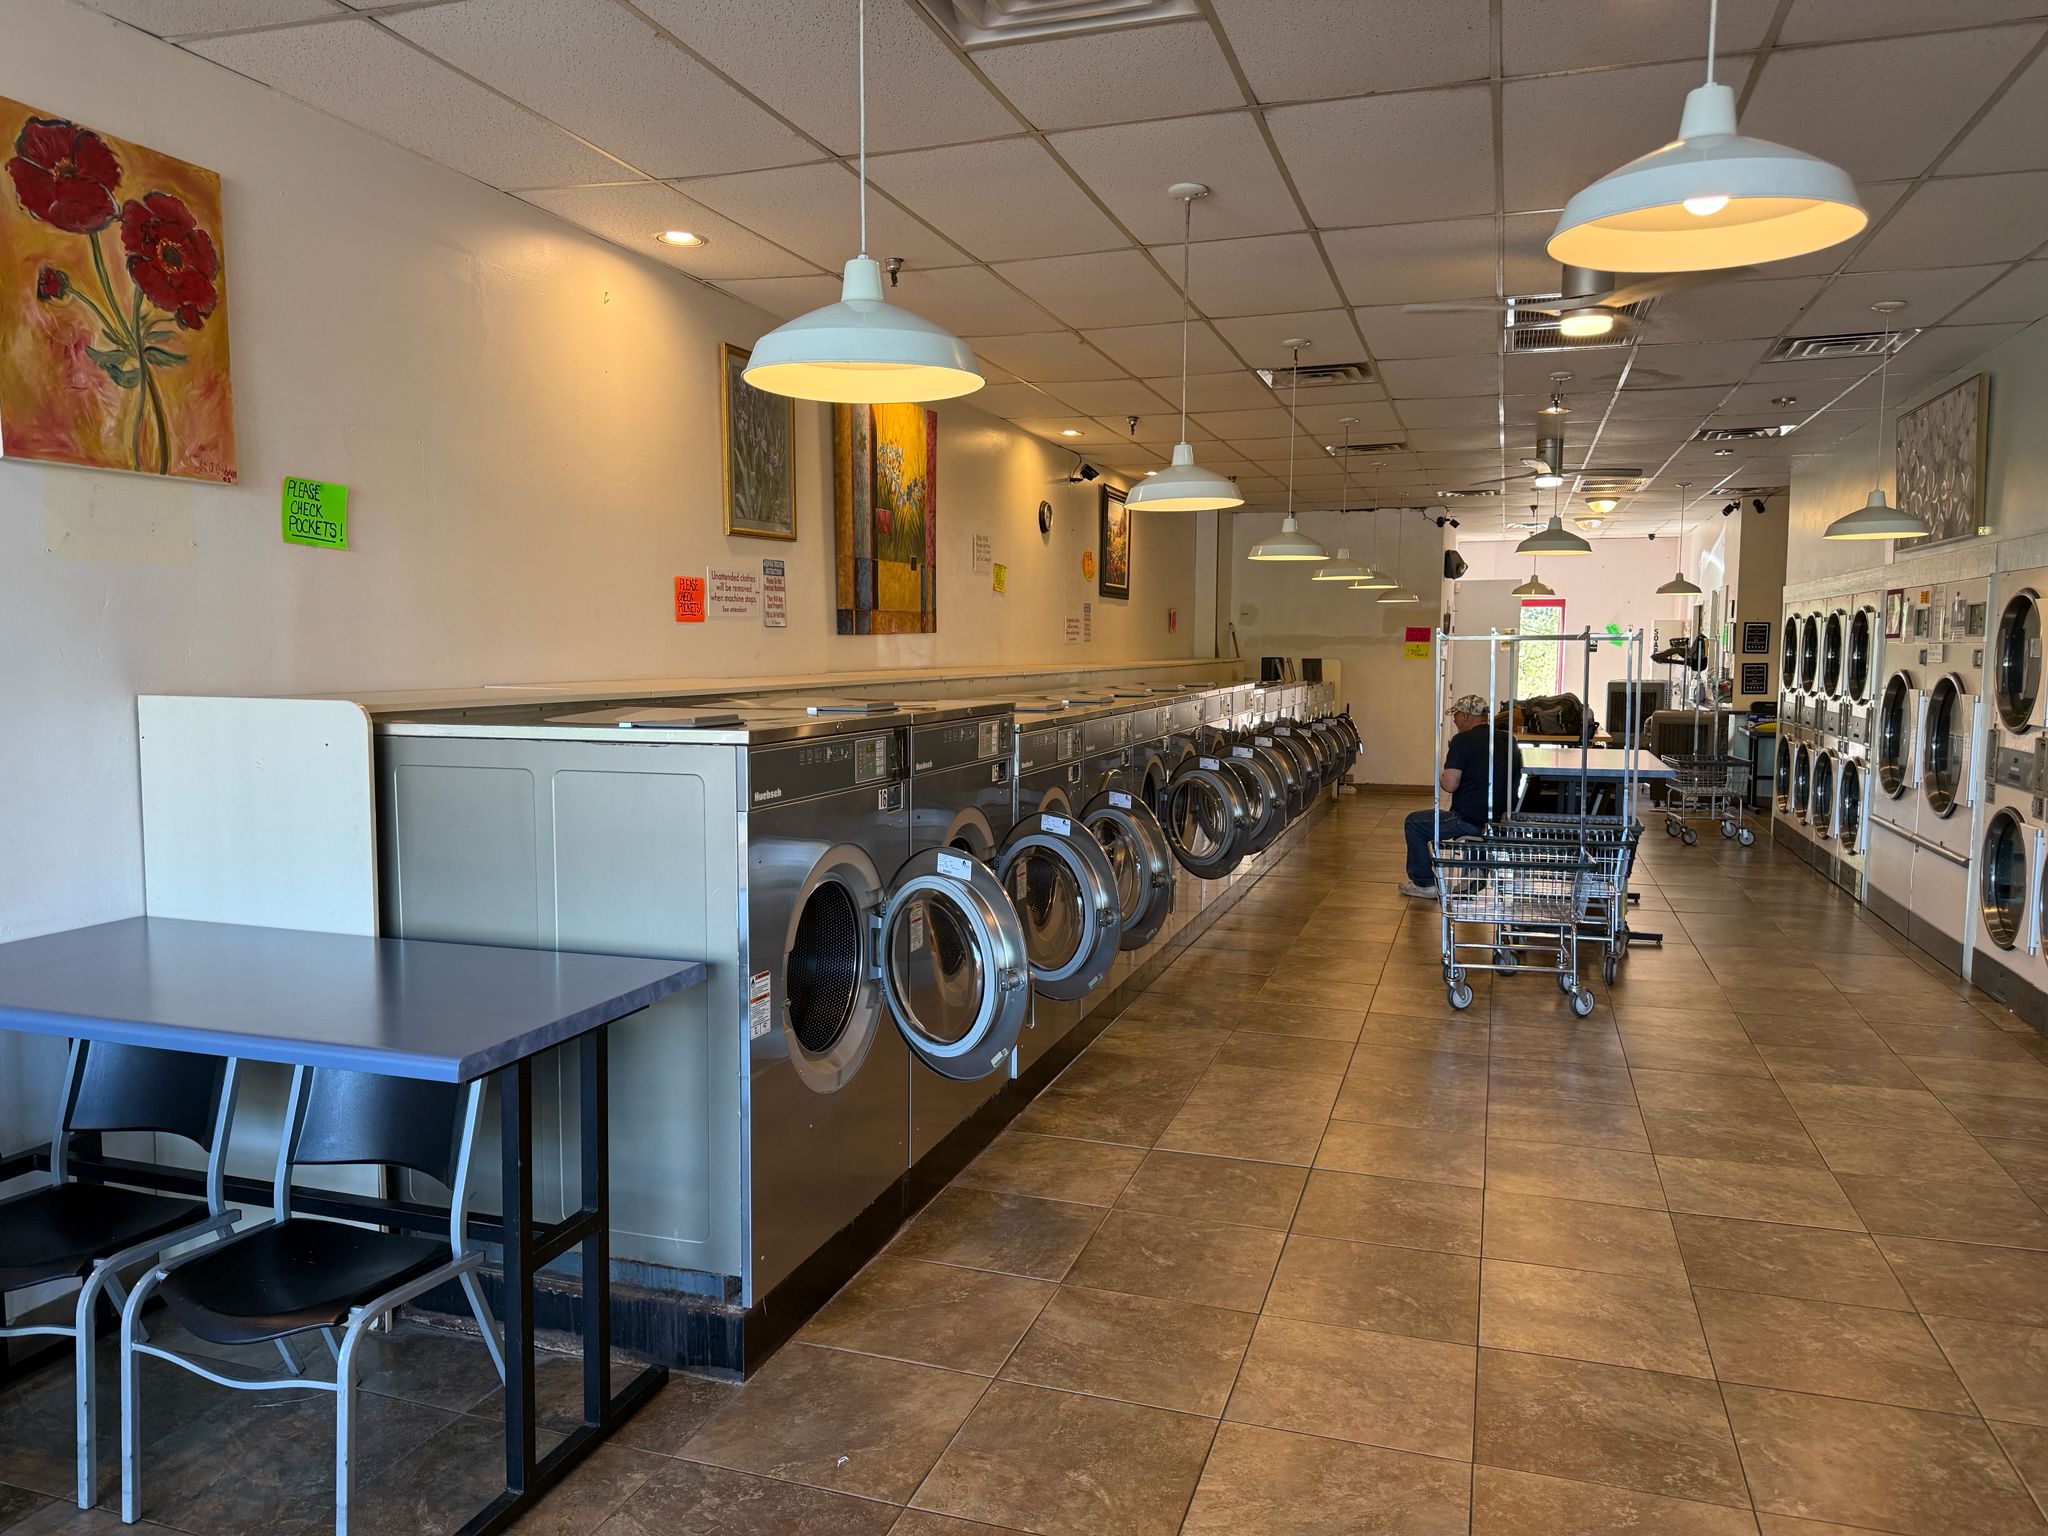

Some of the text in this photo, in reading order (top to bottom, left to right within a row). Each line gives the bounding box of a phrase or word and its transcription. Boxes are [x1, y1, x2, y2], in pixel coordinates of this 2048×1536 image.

[287, 480, 321, 501] PLEASE
[290, 500, 323, 519] CHECK
[711, 570, 755, 582] Unattended clothes
[680, 578, 698, 591] PLEASE
[716, 582, 752, 592] will be removed
[677, 591, 694, 602] CHECK
[711, 592, 723, 601] when
[725, 593, 744, 602] machine
[754, 788, 782, 802] Huebsch
